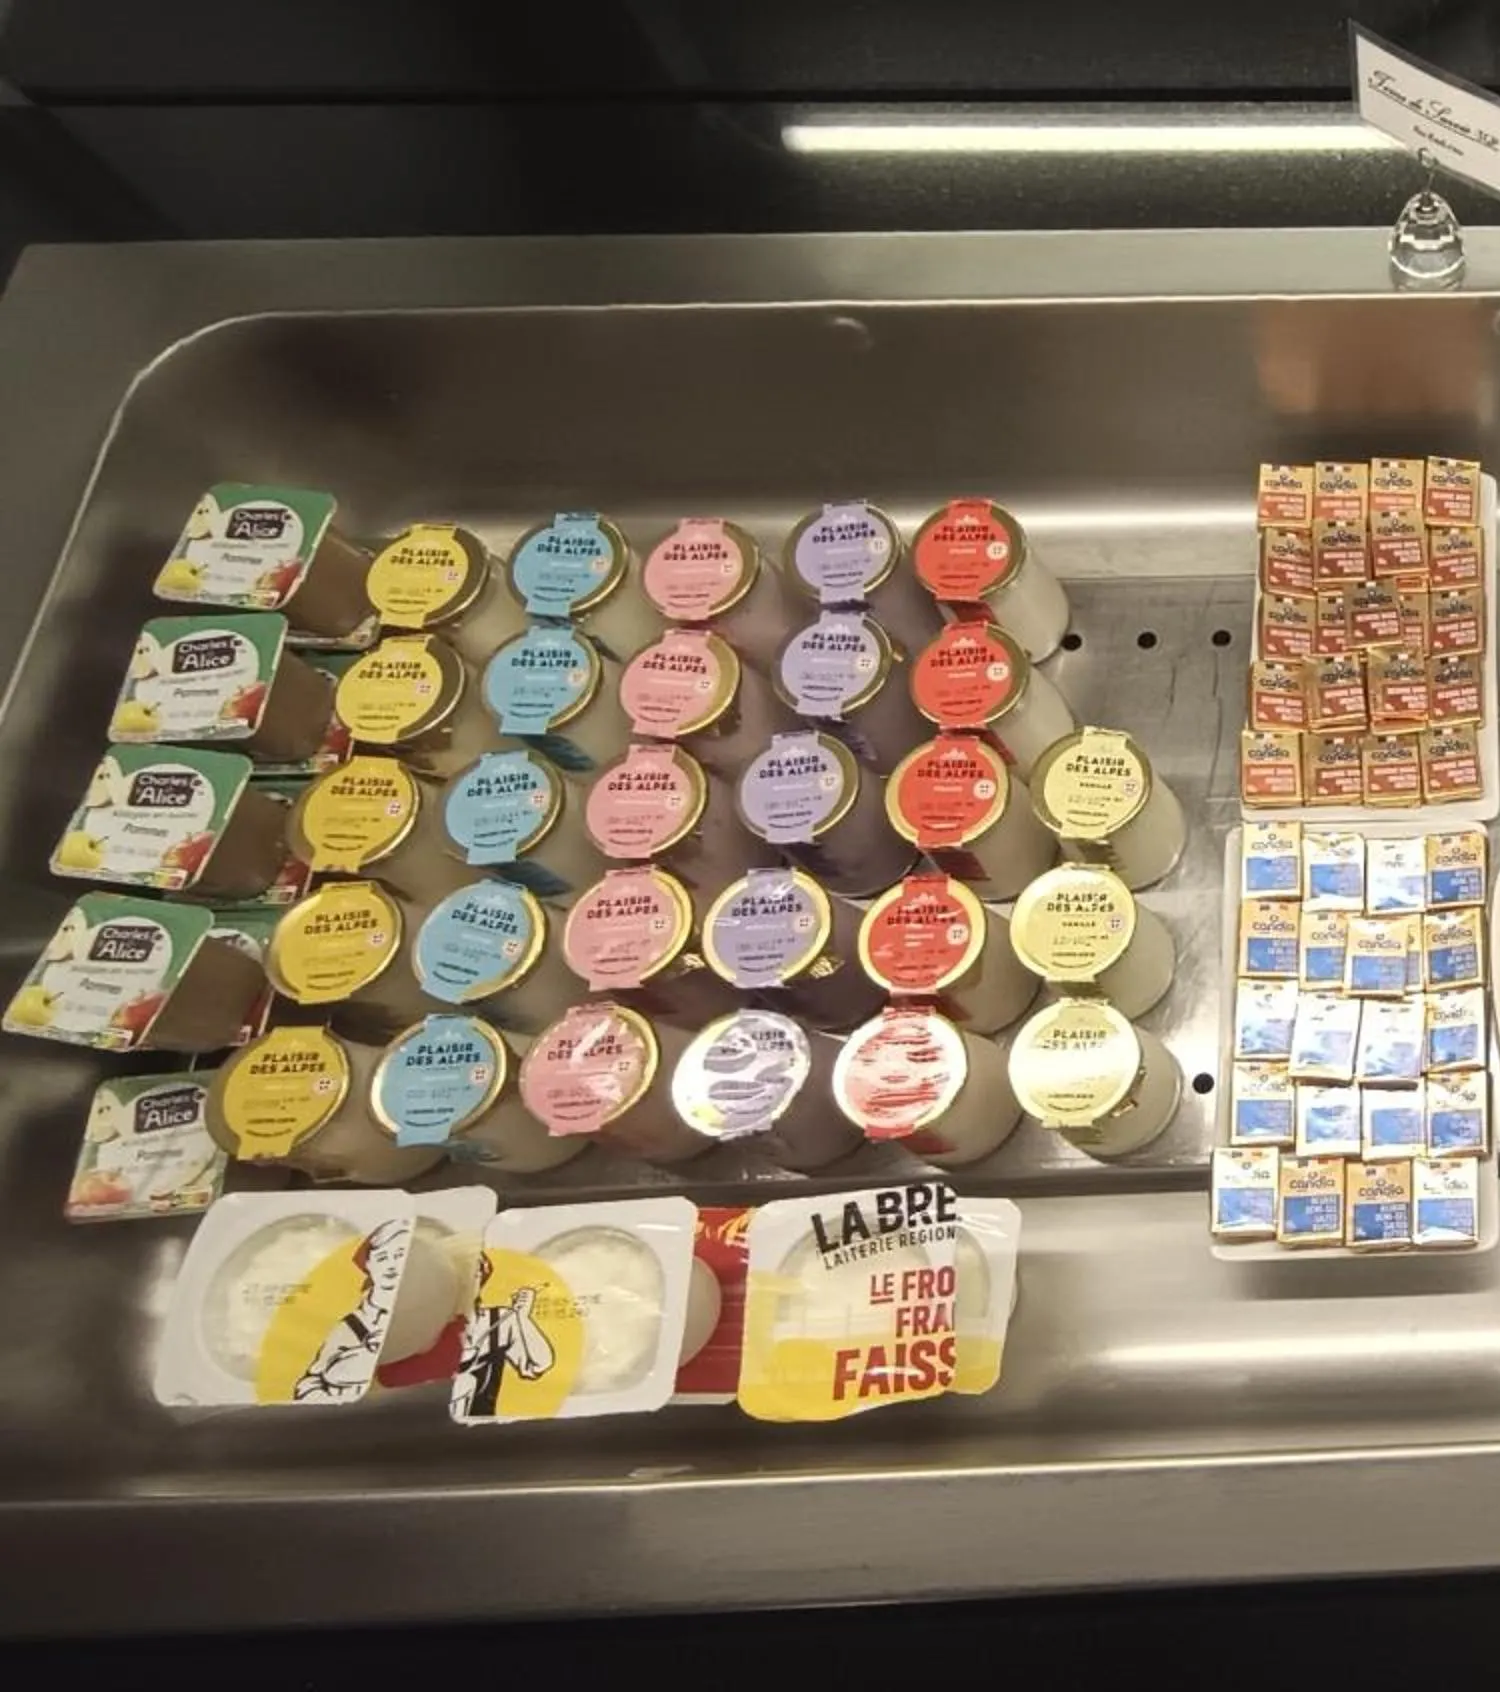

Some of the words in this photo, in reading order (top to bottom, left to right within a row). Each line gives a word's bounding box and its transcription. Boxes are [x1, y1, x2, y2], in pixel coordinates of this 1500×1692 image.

[235, 522, 279, 537] Alice
[182, 653, 233, 670] Alice
[137, 786, 187, 805] Alice
[98, 941, 147, 960] Alice
[811, 1200, 870, 1254] LA
[875, 1182, 957, 1235] BRE
[823, 1237, 894, 1270] LAITERIE
[871, 1273, 895, 1298] LE
[902, 1265, 956, 1301] FRO
[833, 1337, 957, 1401] FAISS
